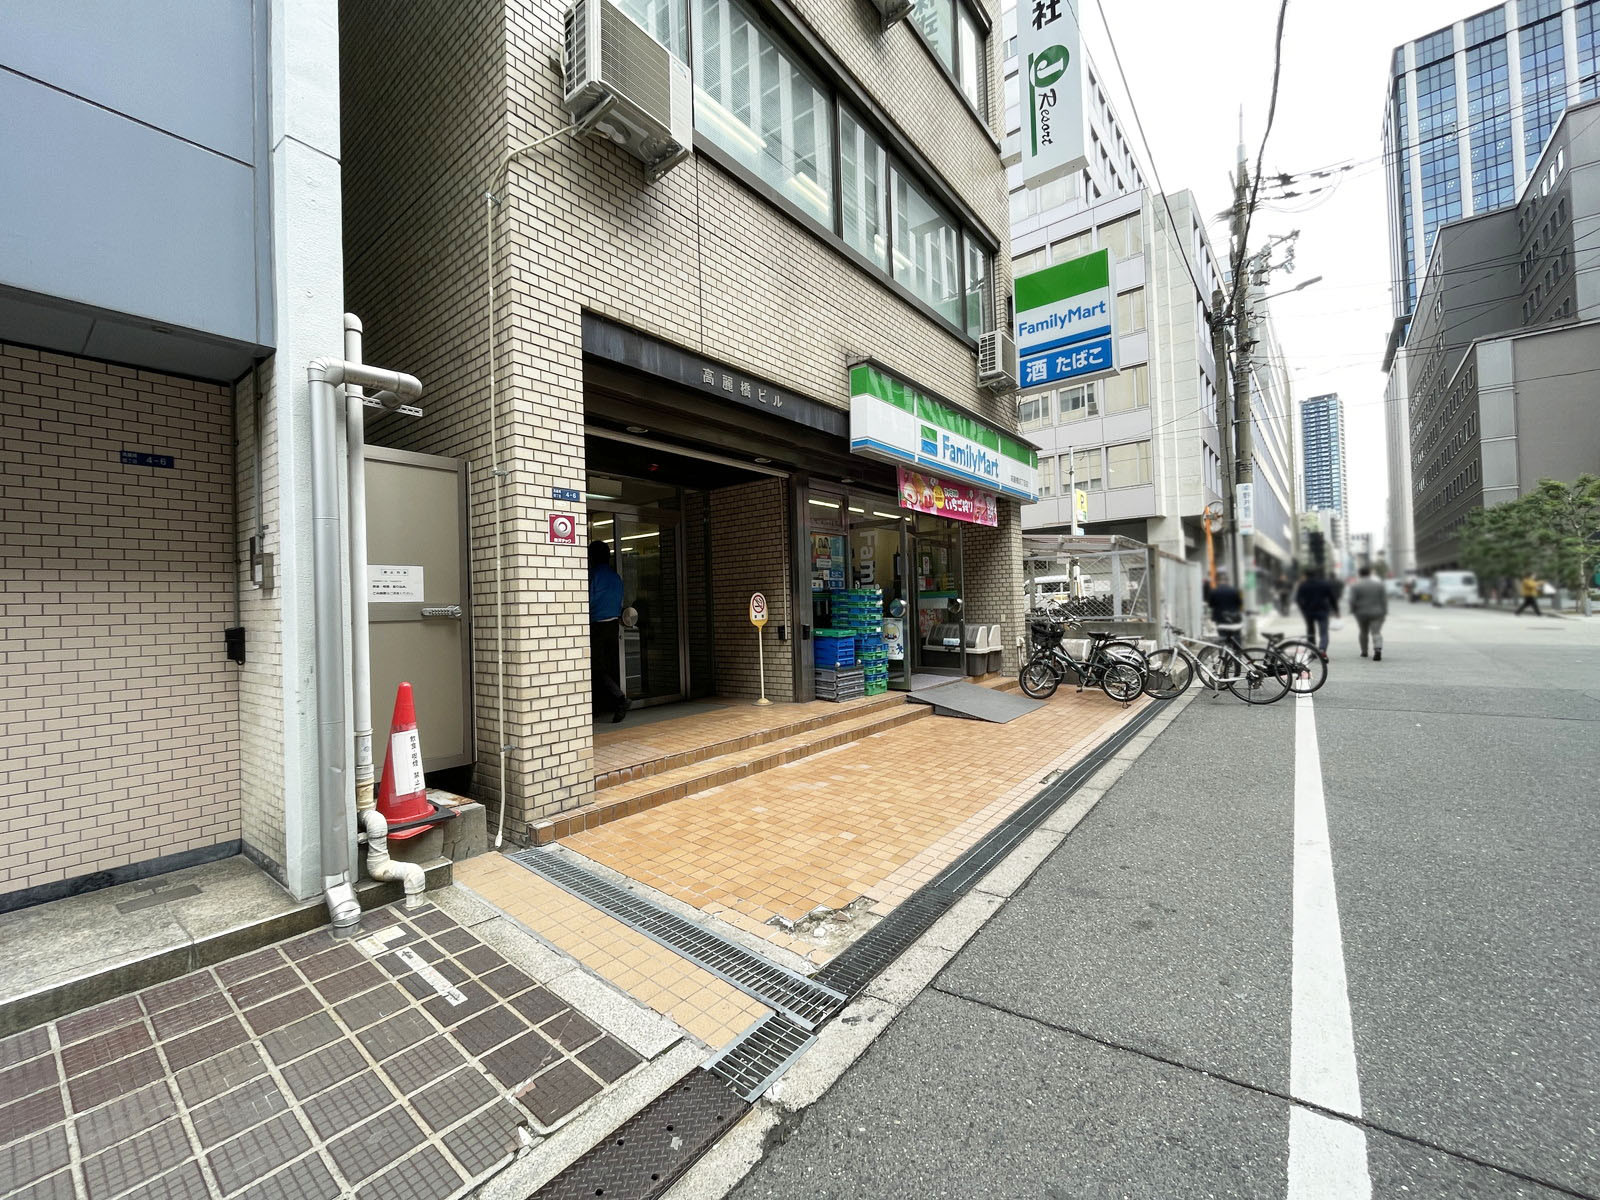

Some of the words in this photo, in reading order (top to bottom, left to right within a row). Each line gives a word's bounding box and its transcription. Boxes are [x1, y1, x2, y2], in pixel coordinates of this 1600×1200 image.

[1038, 88, 1057, 146] Resort
[1018, 300, 1106, 337] FamilyMart
[1026, 358, 1047, 383] 酒
[1056, 346, 1103, 374] たばこ
[702, 367, 783, 408] 高麗橋ビル
[942, 434, 999, 479] FamilyMart
